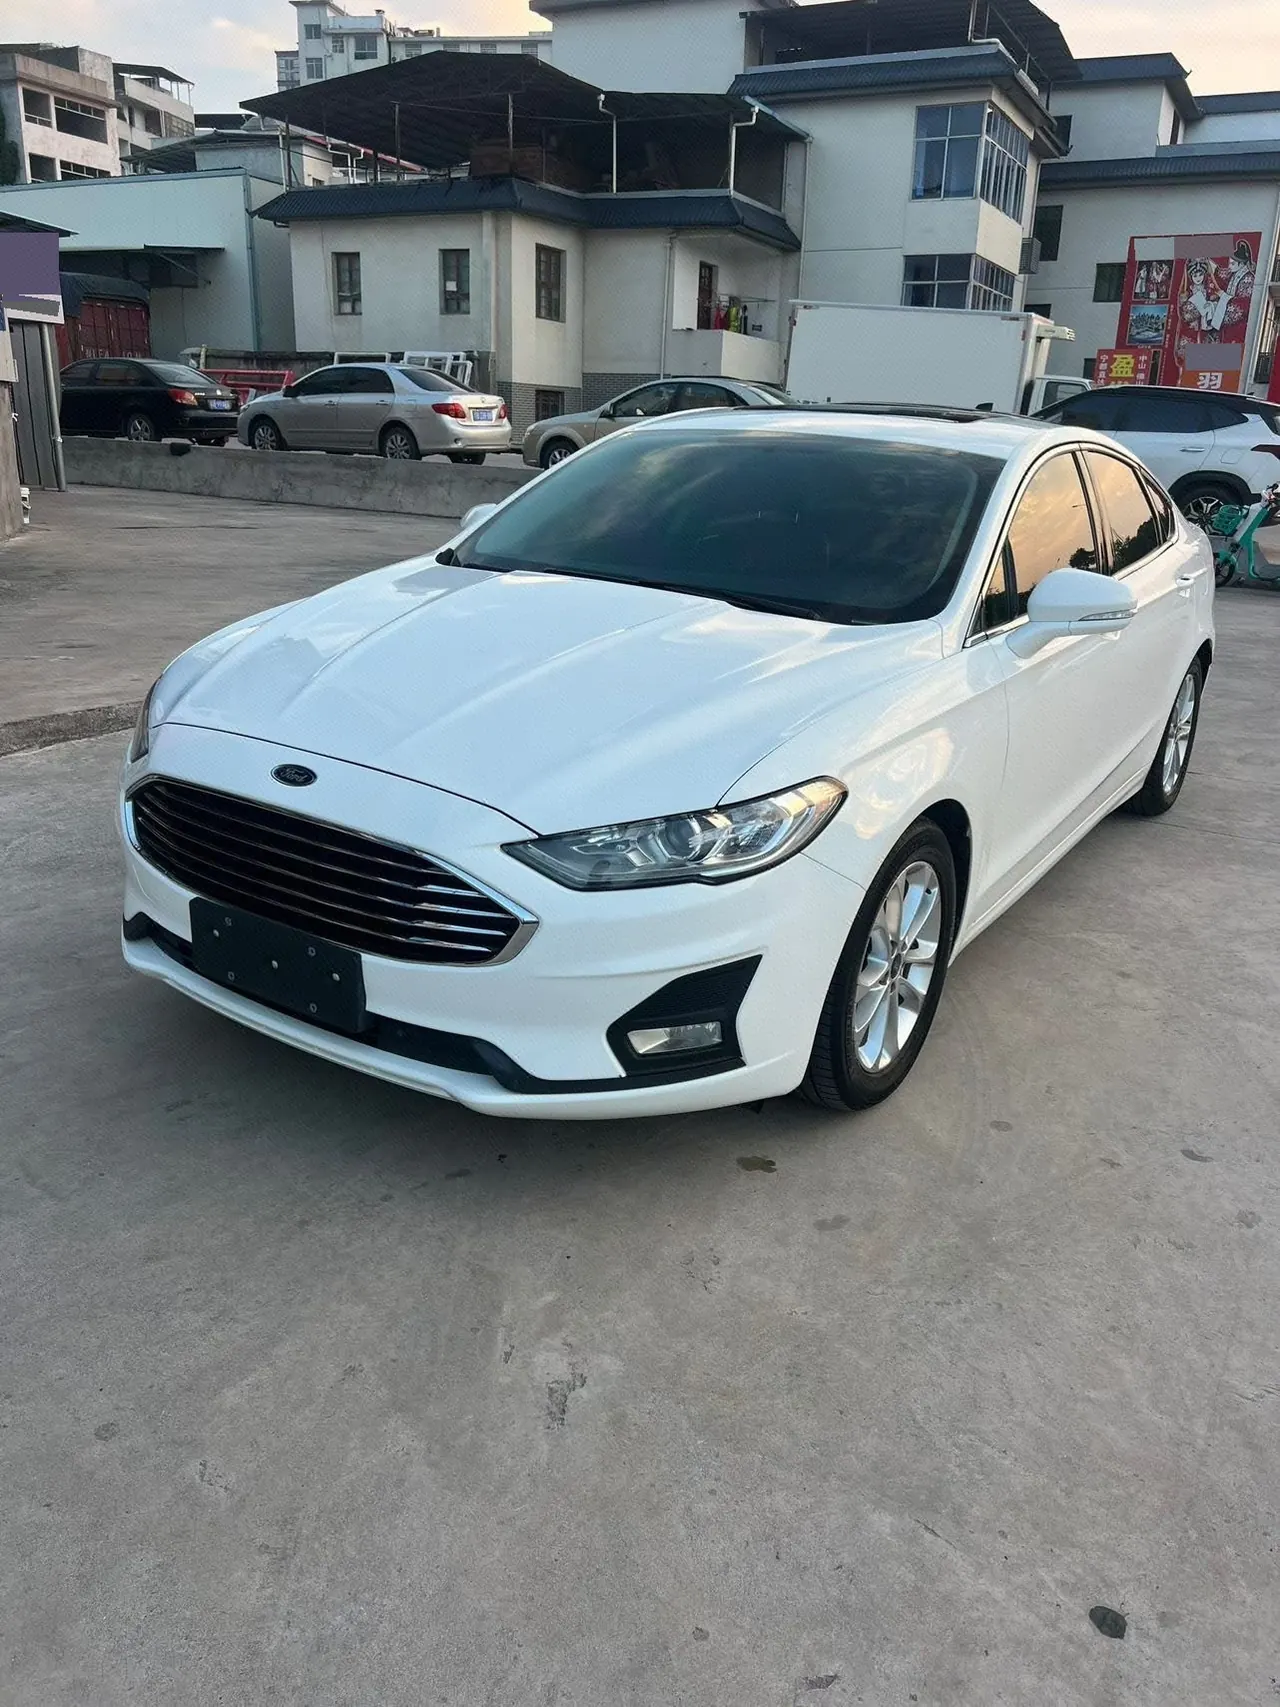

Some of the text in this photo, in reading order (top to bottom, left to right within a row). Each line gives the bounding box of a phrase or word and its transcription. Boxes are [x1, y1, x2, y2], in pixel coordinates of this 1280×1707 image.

[1110, 354, 1135, 377] 盈
[1197, 372, 1223, 389] 羽
[280, 767, 309, 782] Ford
